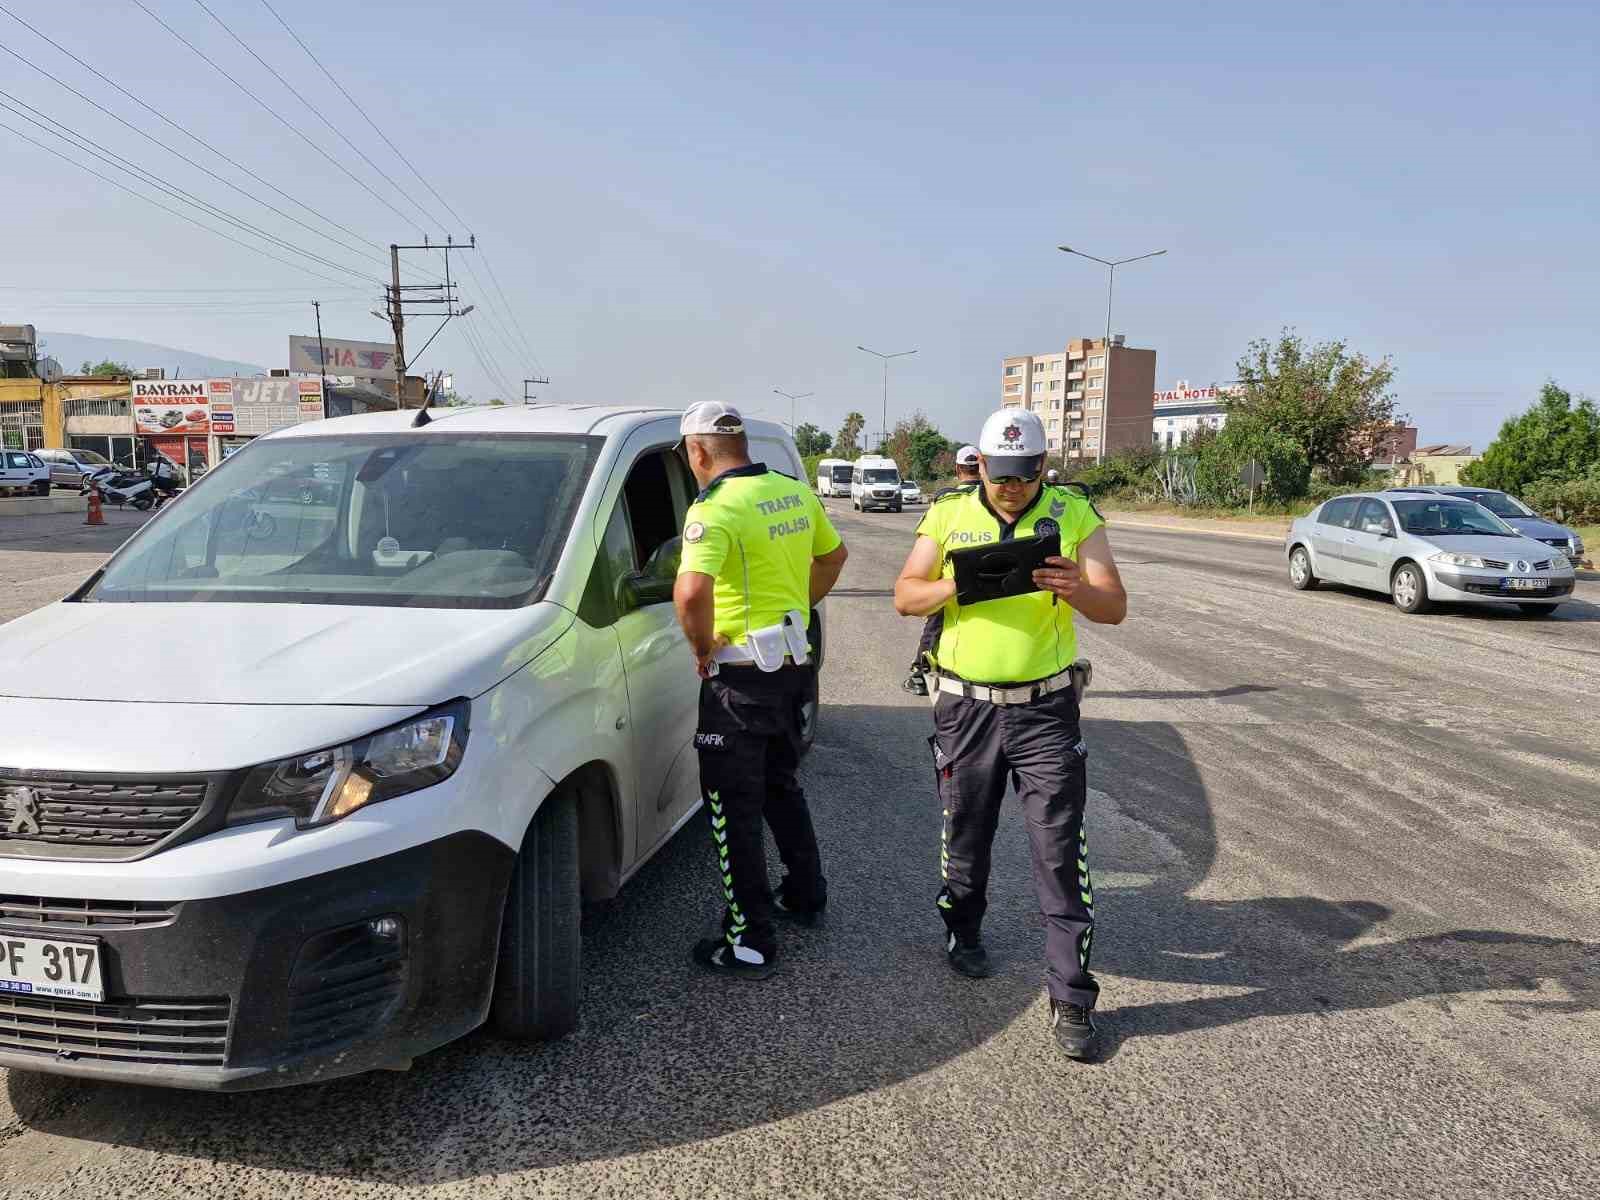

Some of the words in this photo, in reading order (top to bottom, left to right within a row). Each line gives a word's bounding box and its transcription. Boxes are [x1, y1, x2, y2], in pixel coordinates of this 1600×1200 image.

[136, 384, 203, 396] BAYRAM
[242, 381, 289, 402] JET
[42, 943, 95, 984] 317
